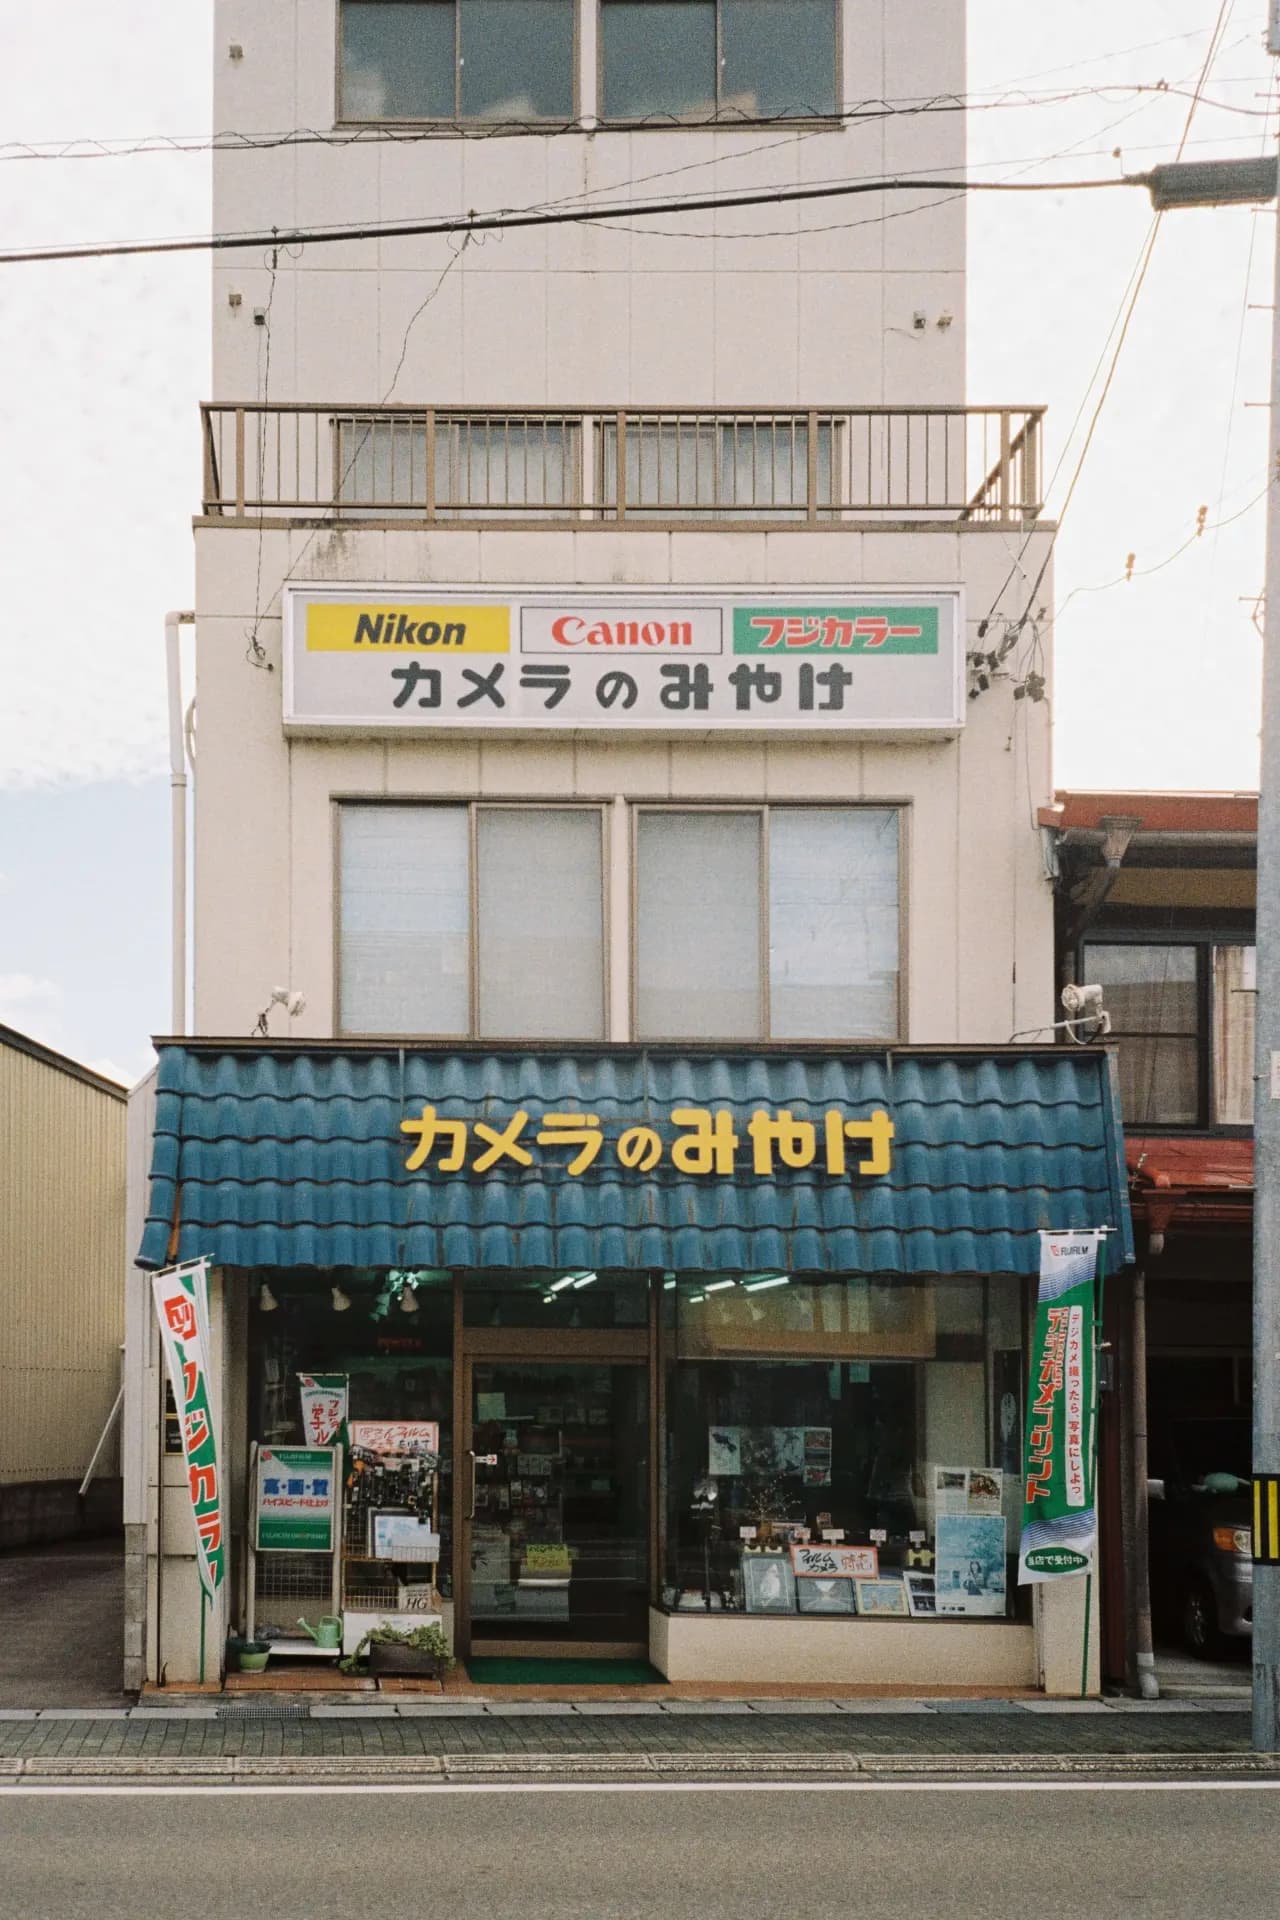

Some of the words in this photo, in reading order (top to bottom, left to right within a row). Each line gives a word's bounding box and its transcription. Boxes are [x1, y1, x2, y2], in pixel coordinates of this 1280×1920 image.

[353, 612, 467, 646] Nikon
[551, 615, 693, 647] Canon
[750, 615, 922, 649] フジカラー
[391, 660, 853, 711] カメラのみやけ
[399, 1104, 896, 1177] カメラのみやけ
